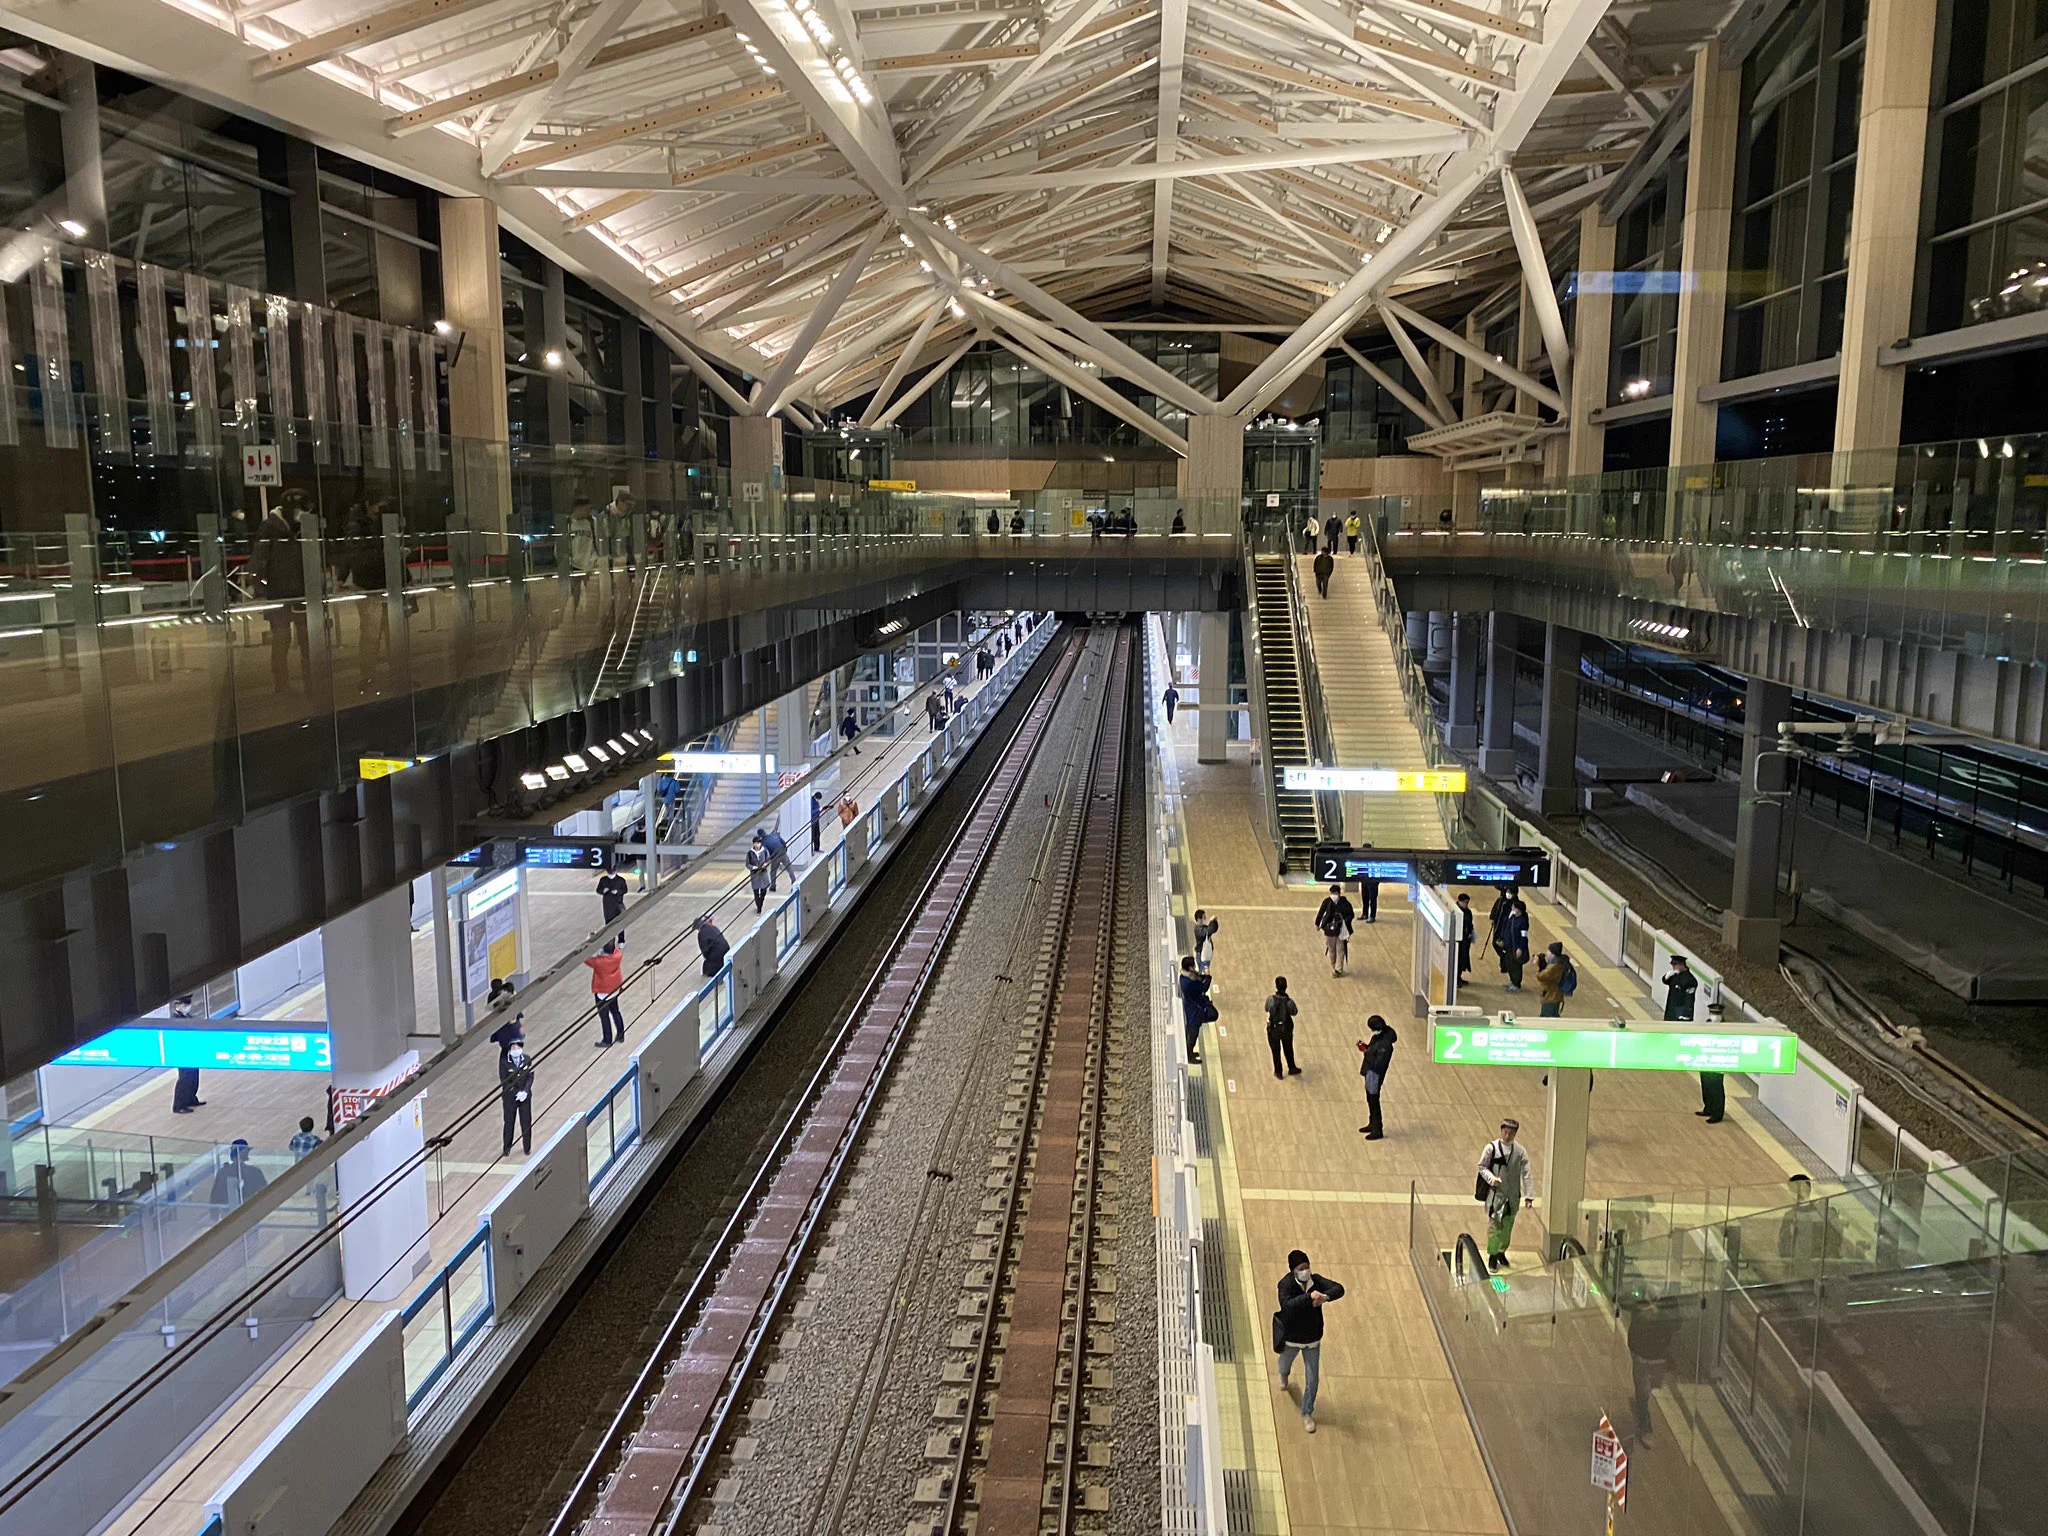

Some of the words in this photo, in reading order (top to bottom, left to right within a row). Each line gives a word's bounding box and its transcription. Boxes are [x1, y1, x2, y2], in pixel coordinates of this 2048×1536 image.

[590, 847, 603, 867] 3
[1323, 860, 1338, 880] 2
[1530, 864, 1539, 884] 1
[315, 1038, 331, 1066] 3
[1443, 1031, 1463, 1059] 2
[1768, 1039, 1782, 1069] 1
